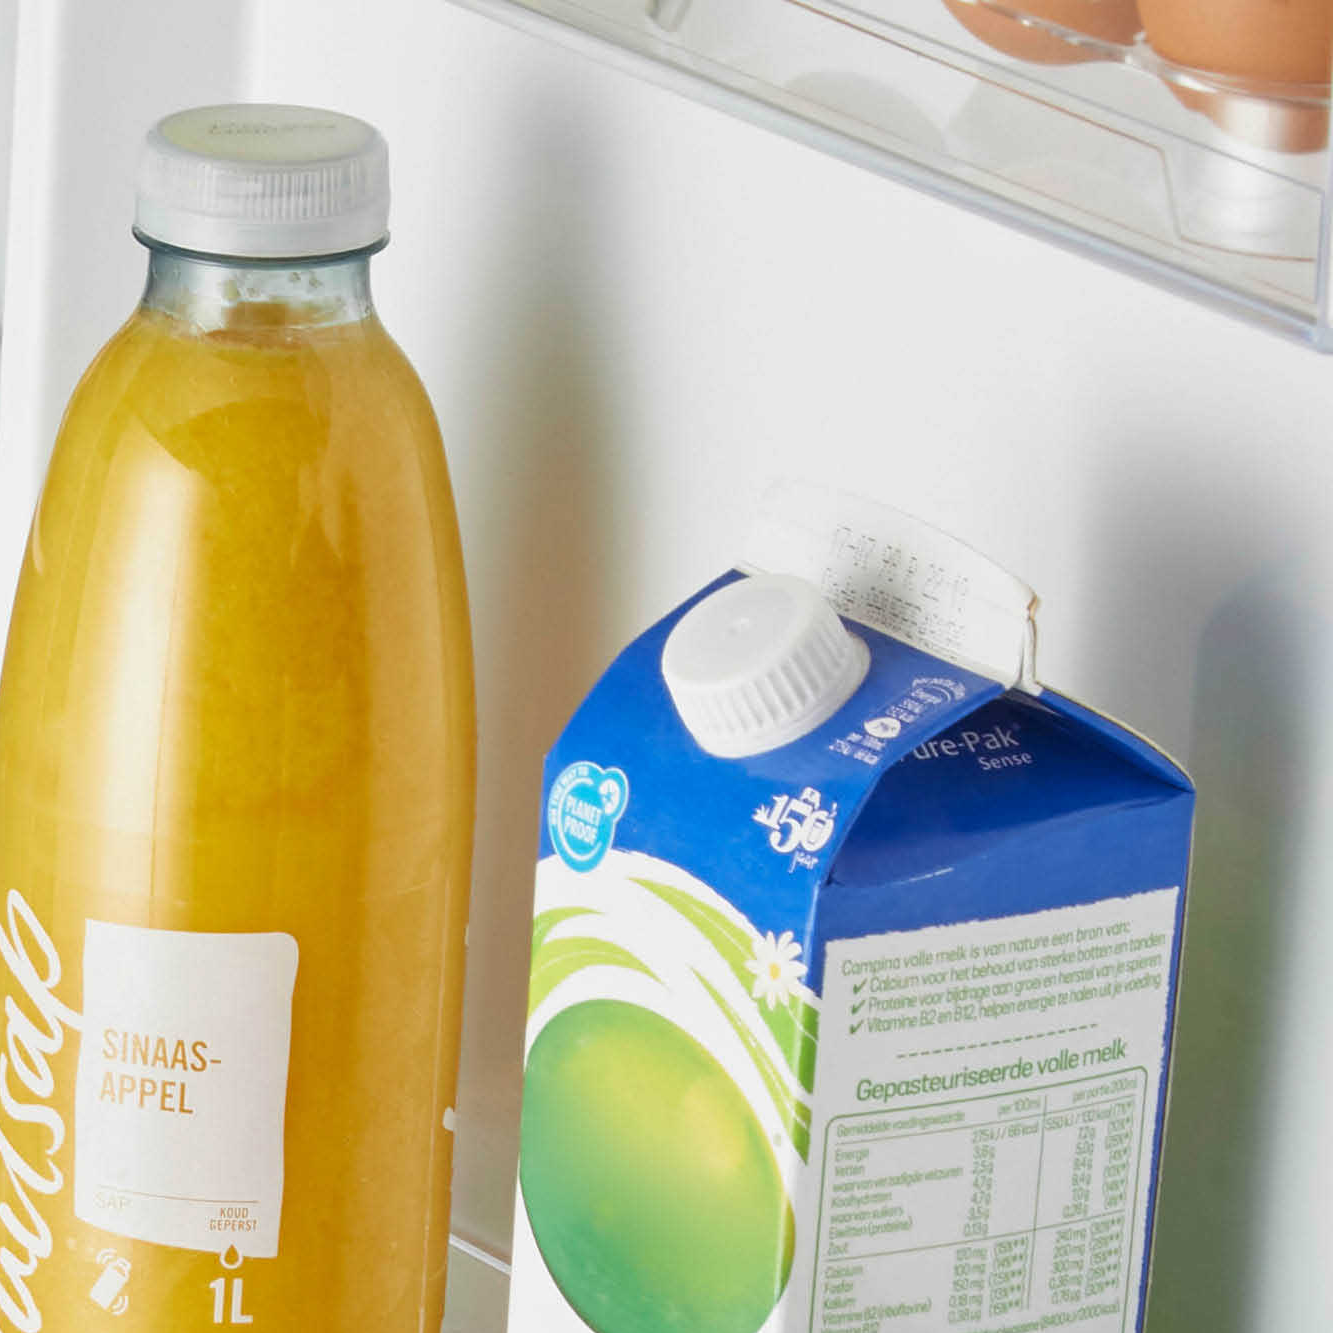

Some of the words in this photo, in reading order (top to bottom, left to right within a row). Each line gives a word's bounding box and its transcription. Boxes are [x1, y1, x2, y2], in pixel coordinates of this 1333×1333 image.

[900, 727, 1019, 763] ure-Pak
[978, 750, 1032, 771] Sense
[841, 957, 900, 976] Campina
[903, 950, 933, 968] volle
[935, 944, 966, 962] melk
[1009, 935, 1049, 952] nature
[102, 1027, 222, 1073] SINAAS-
[856, 1055, 1032, 1103] Gepasteuriseerde
[1037, 1048, 1080, 1077] volle
[1083, 1038, 1128, 1068] melk
[99, 1070, 194, 1115] APPEL
[209, 1218, 258, 1232] GEPERST
[220, 1207, 249, 1220] KOUD
[209, 1277, 254, 1324] 1L
